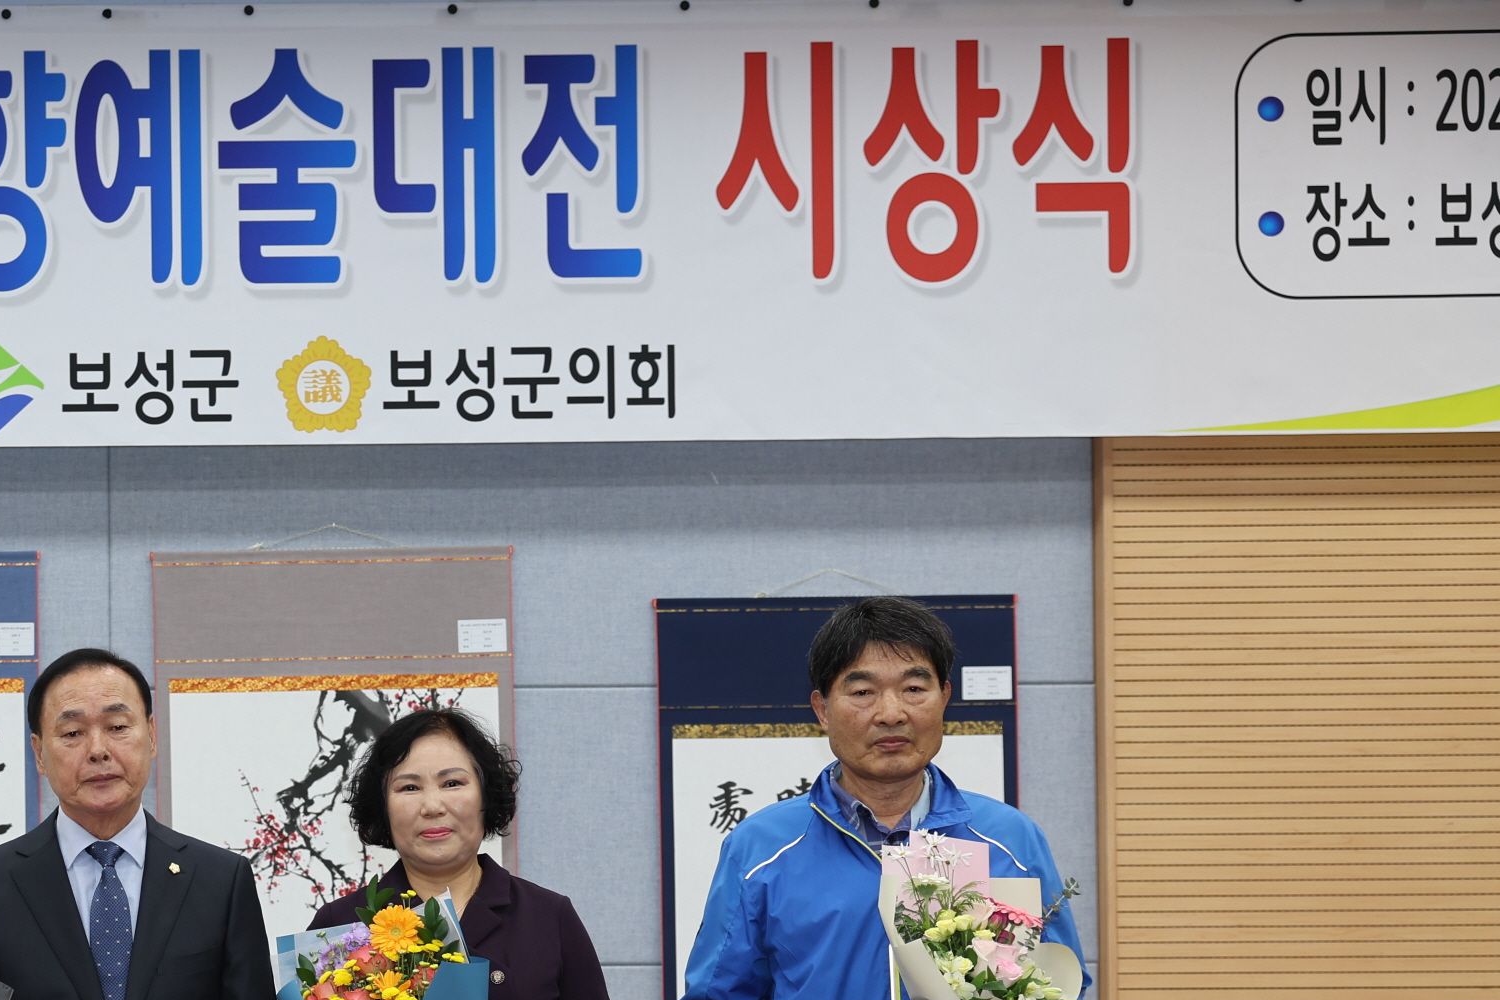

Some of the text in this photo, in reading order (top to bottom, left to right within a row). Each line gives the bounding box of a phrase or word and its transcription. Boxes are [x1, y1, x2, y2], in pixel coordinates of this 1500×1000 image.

[1306, 66, 1386, 146] 일시
[716, 37, 1130, 282] 시상식
[1306, 182, 1390, 262] 장소
[62, 349, 239, 425] 보성군
[302, 369, 342, 403] 議
[383, 344, 676, 422] 보성군의회
